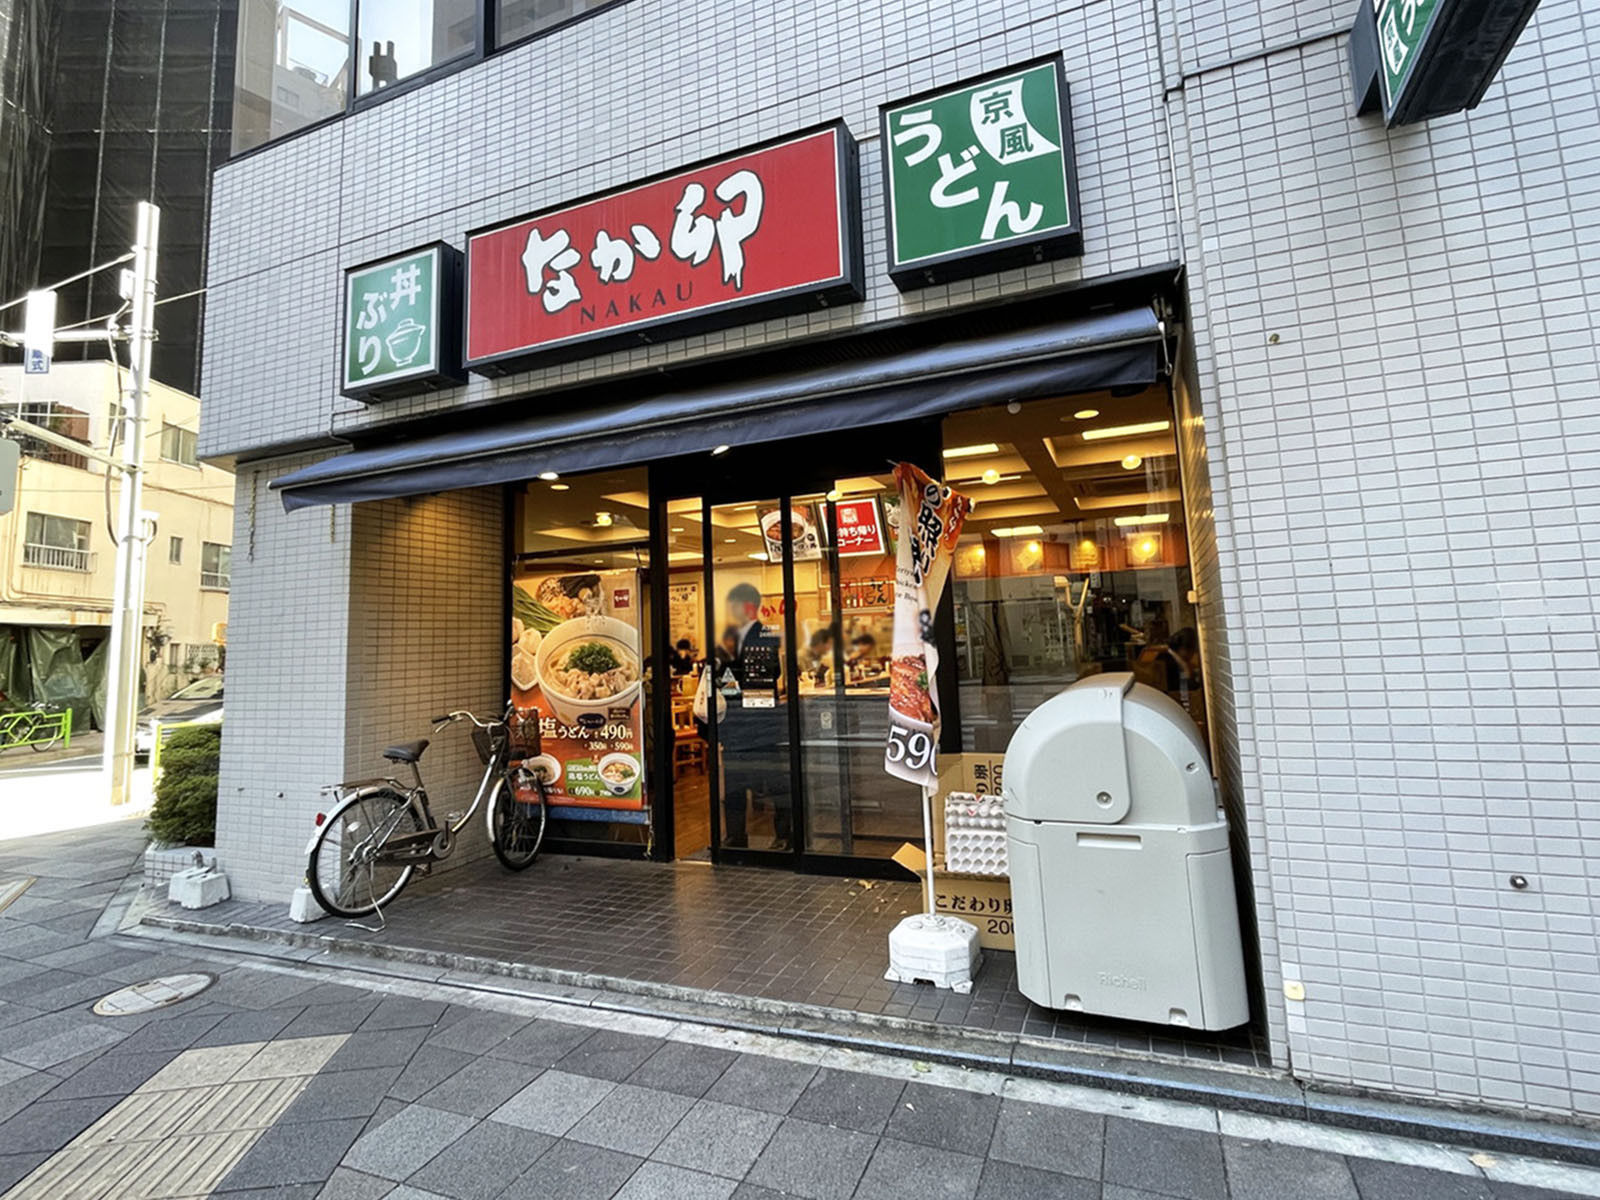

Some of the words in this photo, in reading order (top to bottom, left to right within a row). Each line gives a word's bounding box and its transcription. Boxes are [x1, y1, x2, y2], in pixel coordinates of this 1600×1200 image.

[979, 89, 1034, 160] 京風
[893, 108, 1044, 241] うどん
[521, 168, 765, 315] なか卯
[580, 281, 693, 325] NAKAU
[837, 524, 876, 537] 持ち帰り
[837, 536, 874, 547] コーナー
[987, 919, 1015, 935] 20
